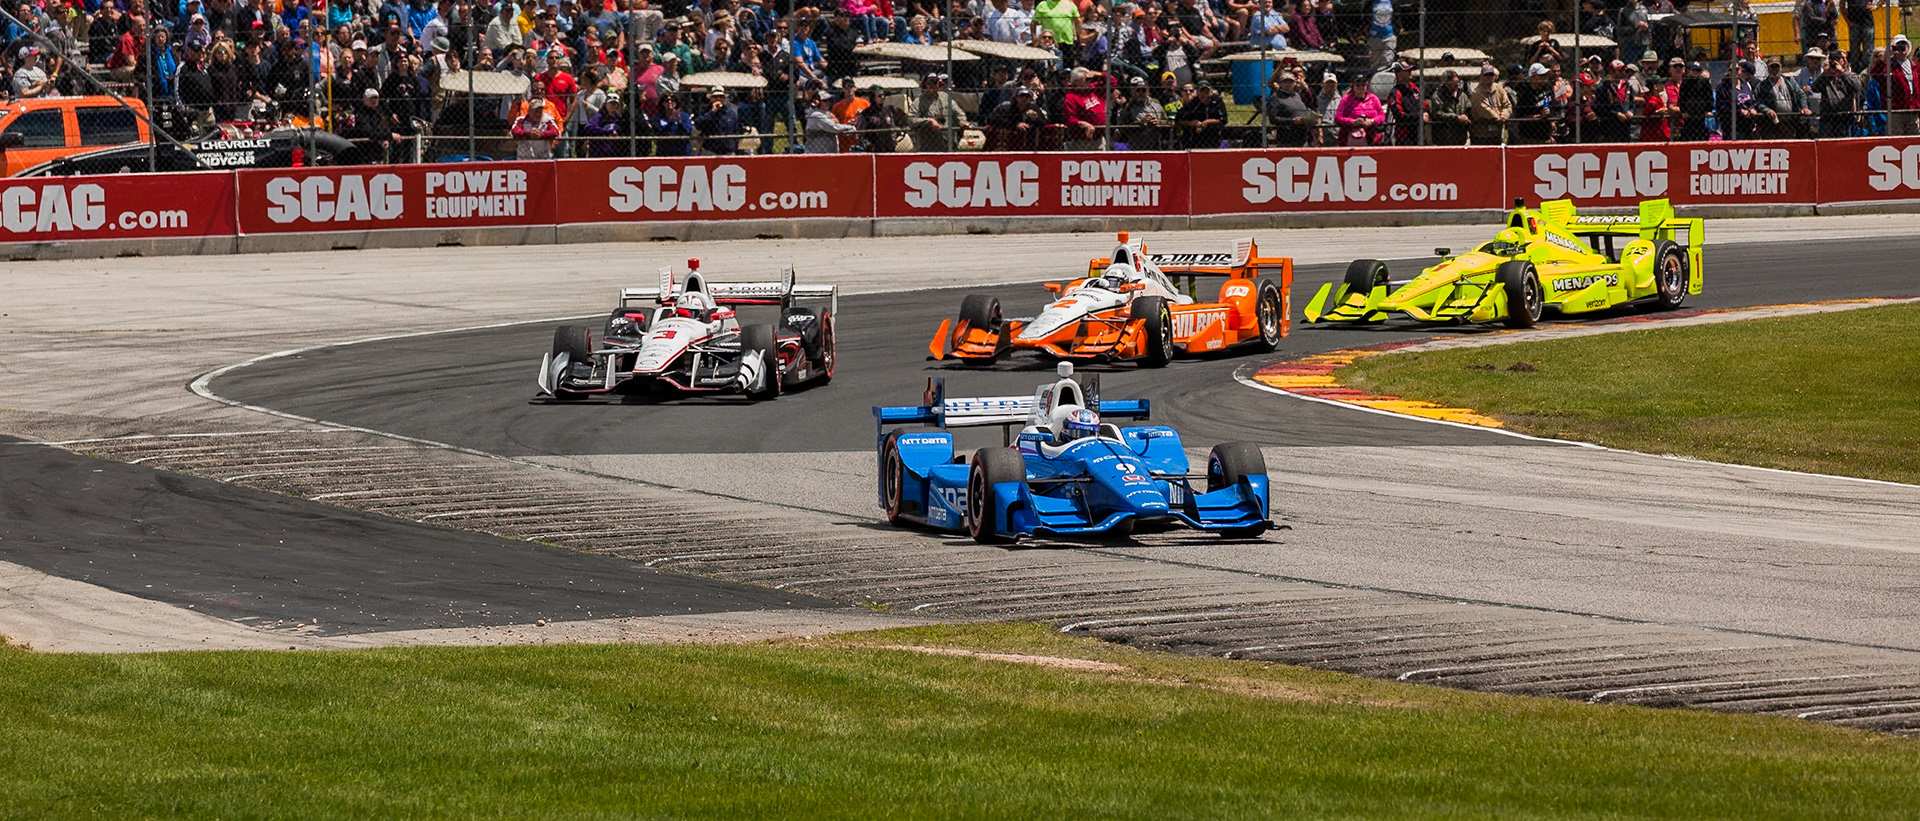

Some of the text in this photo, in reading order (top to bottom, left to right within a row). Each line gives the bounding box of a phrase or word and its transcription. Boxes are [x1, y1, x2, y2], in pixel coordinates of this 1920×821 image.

[201, 139, 271, 150] CHEVROLET
[196, 156, 255, 167] INDYCAR
[1061, 160, 1162, 184] POWER
[1690, 148, 1790, 172] POWER
[426, 170, 527, 195] POWER
[904, 161, 1039, 208] SCAG
[1242, 156, 1457, 204] SCAG.com
[1534, 151, 1668, 200] SCAG
[1690, 172, 1788, 196] EQUIPMENT
[266, 173, 403, 223] SCAG
[609, 164, 828, 213] SCAG.com
[1061, 185, 1160, 207] EQUIPMENT
[0, 183, 188, 233] CAG.com
[426, 194, 527, 220] EQUIPMENT
[1695, 253, 1700, 279] 1
[1052, 299, 1078, 309] 2
[653, 330, 677, 339] 3
[1115, 463, 1136, 474] 9
